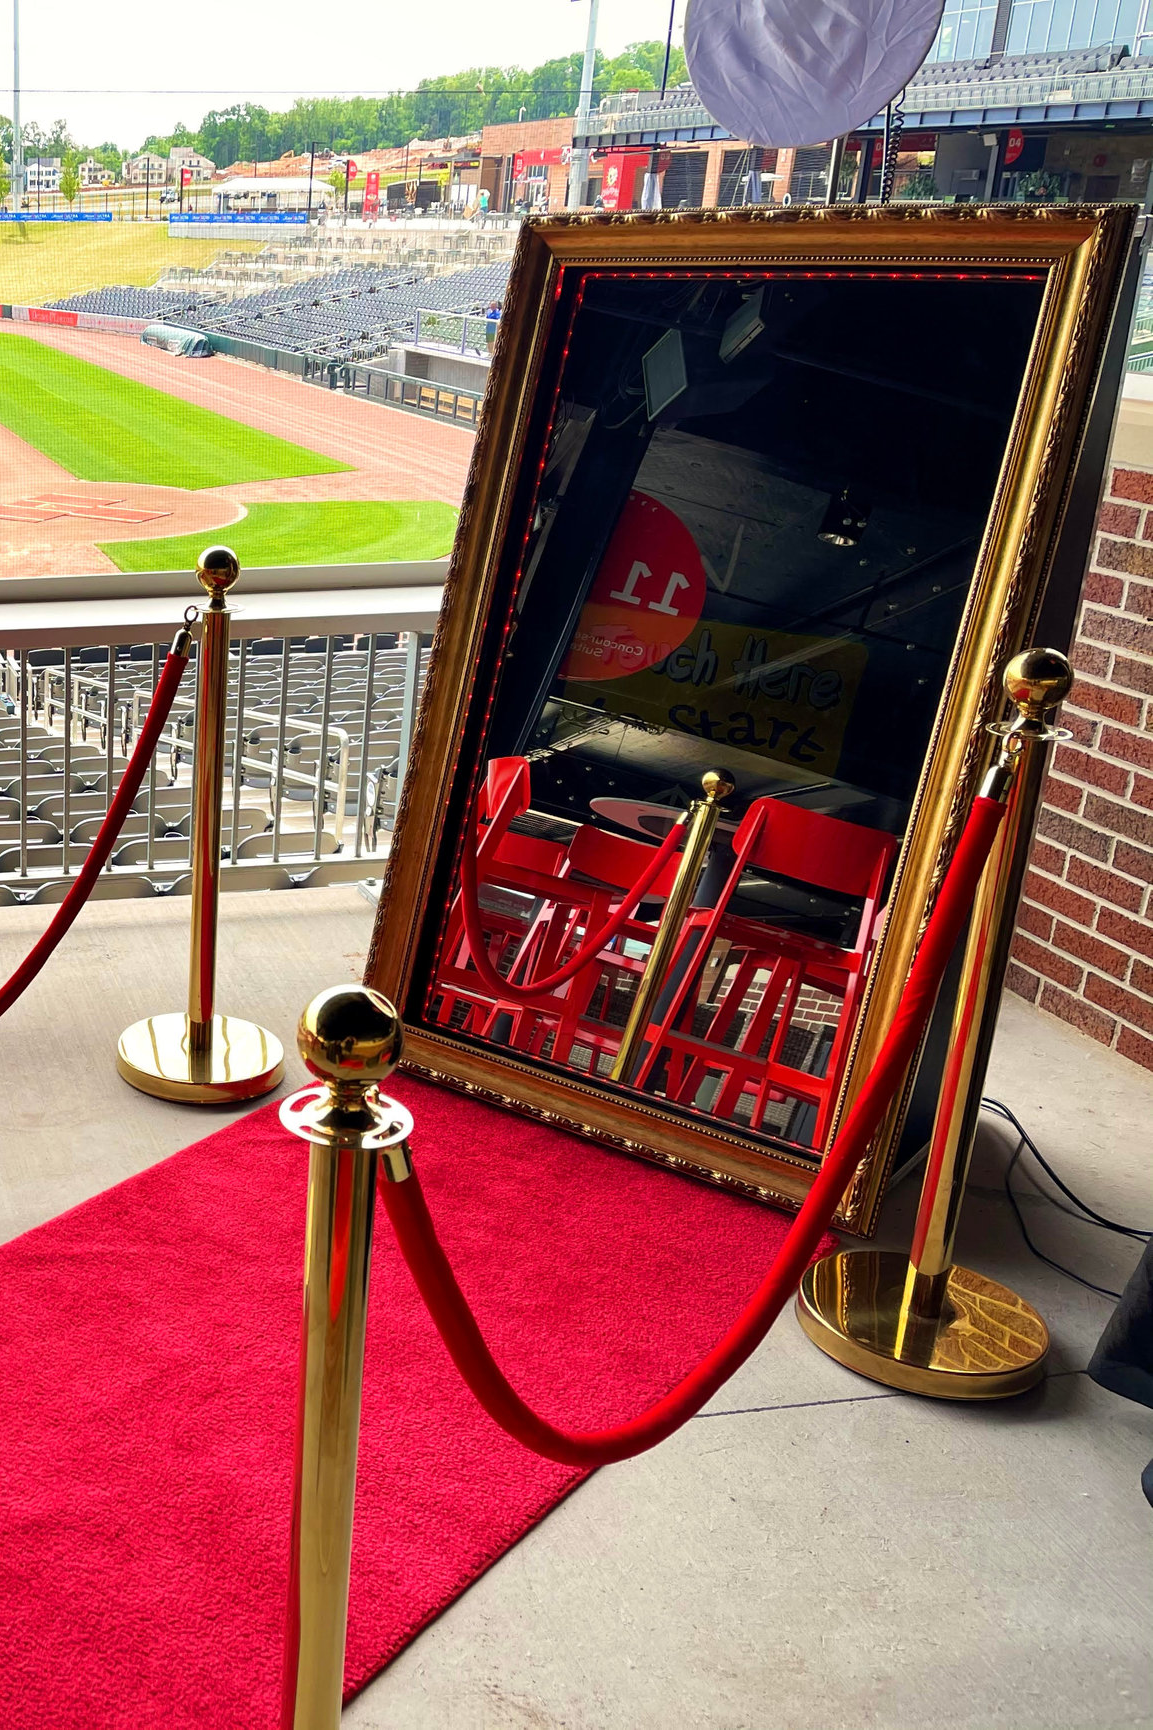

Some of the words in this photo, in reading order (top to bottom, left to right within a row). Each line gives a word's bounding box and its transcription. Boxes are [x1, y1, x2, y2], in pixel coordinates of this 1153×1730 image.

[1008, 138, 1021, 148] 04
[731, 634, 843, 710] Here
[668, 704, 825, 761] Start
